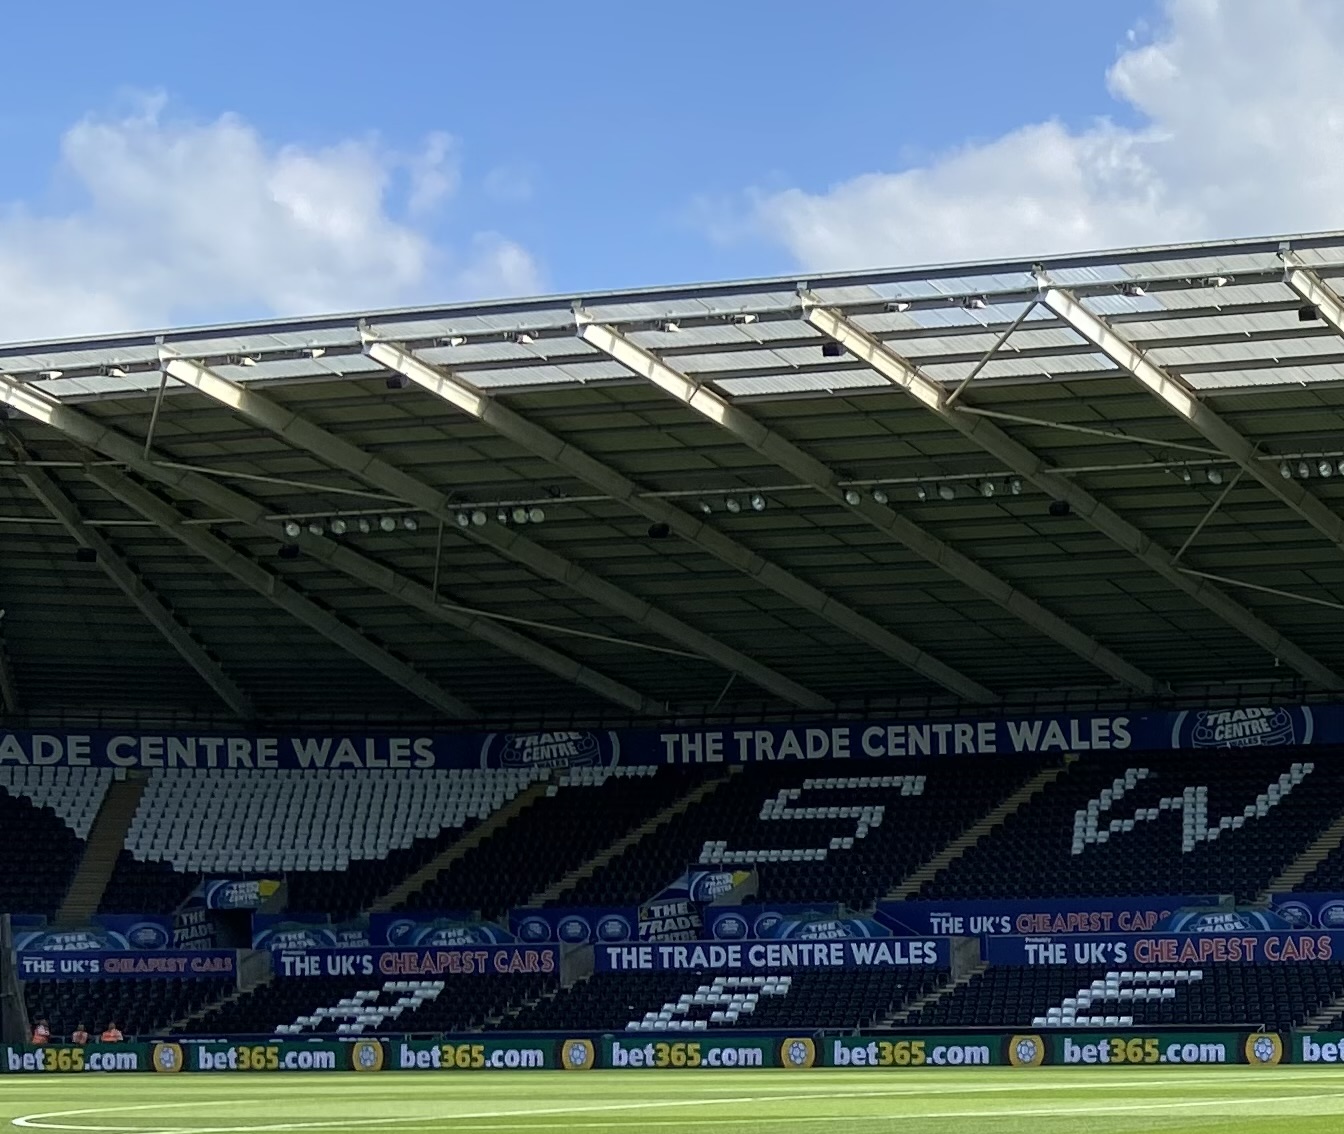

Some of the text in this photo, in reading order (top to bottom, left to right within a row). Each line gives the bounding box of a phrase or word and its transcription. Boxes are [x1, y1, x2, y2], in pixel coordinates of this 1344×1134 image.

[1206, 707, 1276, 727] TRADE
[1214, 718, 1272, 741] CENTRE
[106, 736, 278, 768] CENTRE
[291, 737, 436, 768] WALES
[523, 741, 579, 762] CENTRE
[660, 717, 1132, 763] THE TRADE CENTRE WALES
[651, 902, 688, 917] THE
[639, 915, 703, 935] TRADE
[930, 917, 964, 934] THE
[970, 916, 1011, 933] UK'S
[1016, 911, 1113, 933] CHEAPEST
[606, 941, 937, 970] THE TRADE CENTRE WALES
[1024, 935, 1332, 965] THE UK'S CHEAPEST CARS
[22, 960, 56, 973] THE
[60, 959, 100, 973] UK'S
[281, 949, 555, 977] THE UK'S CHEAPEST CARS
[7, 1046, 138, 1071] bet365.com
[199, 1046, 335, 1071] bet365.com
[400, 1043, 544, 1069] bet365.com
[612, 1041, 763, 1068] bet365.com
[834, 1040, 990, 1066] bet365.com
[1064, 1038, 1226, 1064] bet365.com
